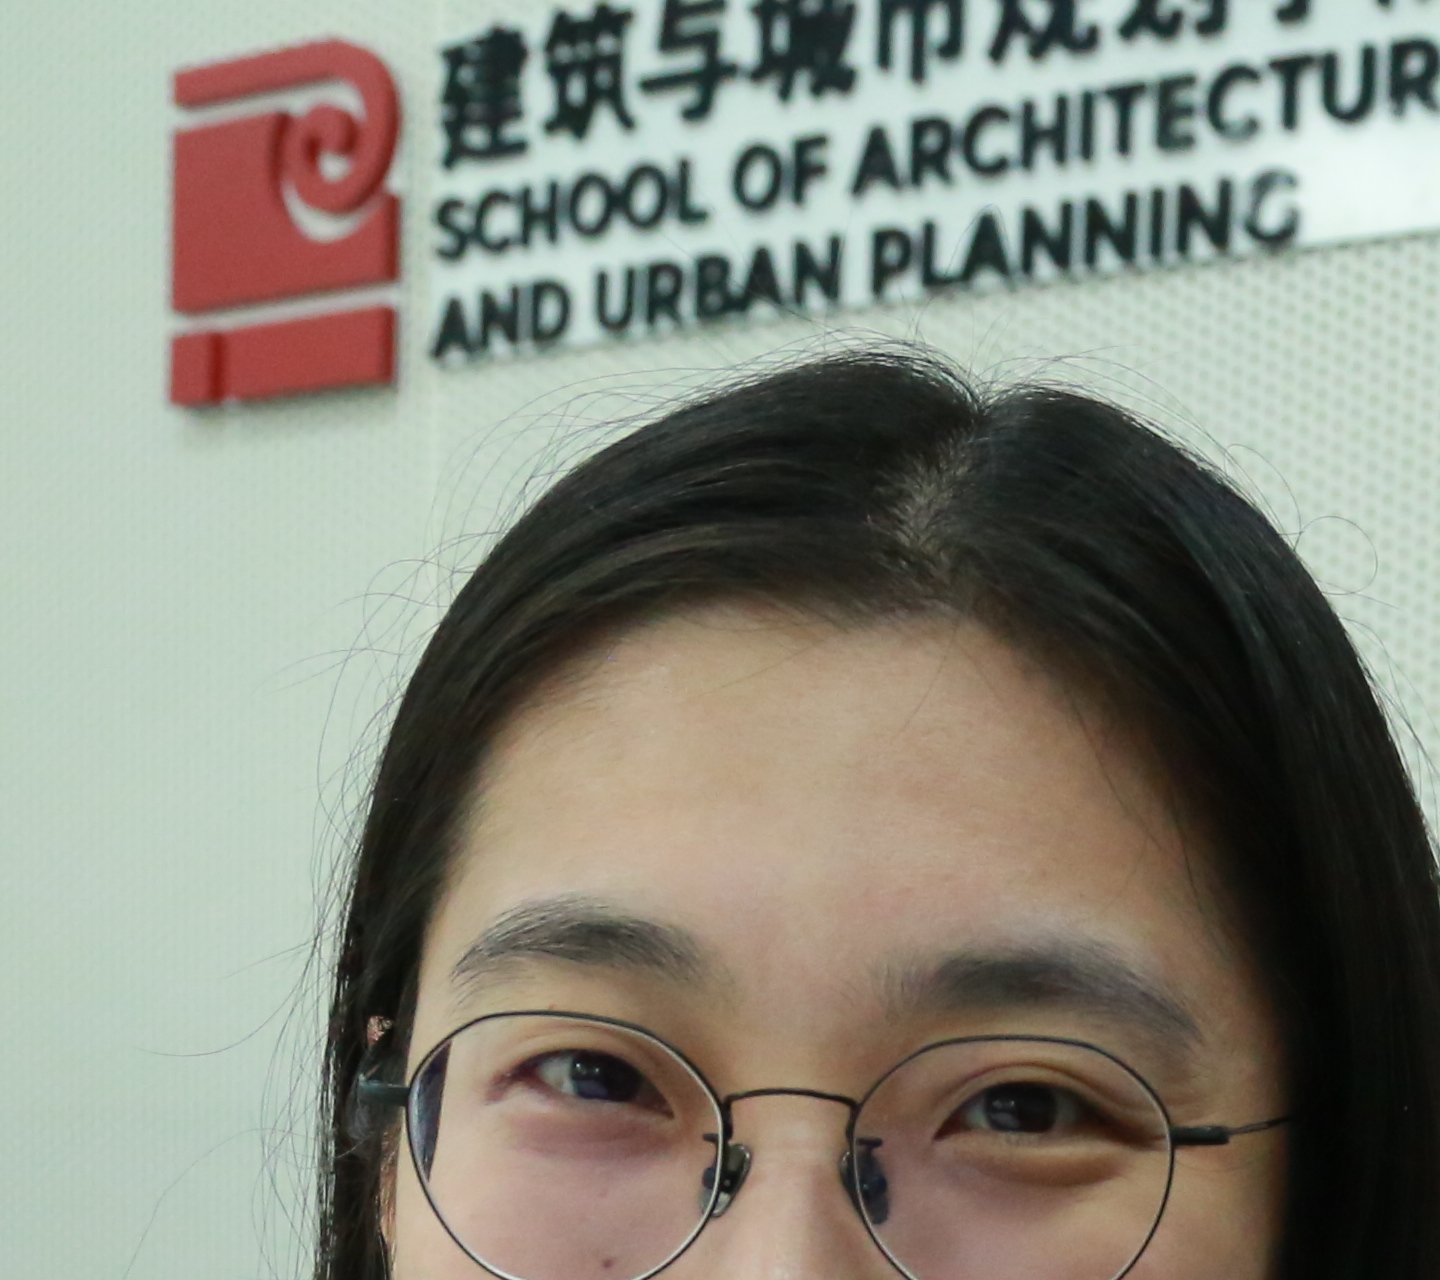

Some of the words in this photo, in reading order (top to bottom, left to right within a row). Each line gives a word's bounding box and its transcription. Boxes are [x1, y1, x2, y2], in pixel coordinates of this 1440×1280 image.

[431, 279, 570, 358] AND
[596, 236, 842, 331] URBAN
[872, 168, 1301, 297] PLANNING
[436, 158, 709, 261] SCHOOL
[733, 134, 829, 212] OF
